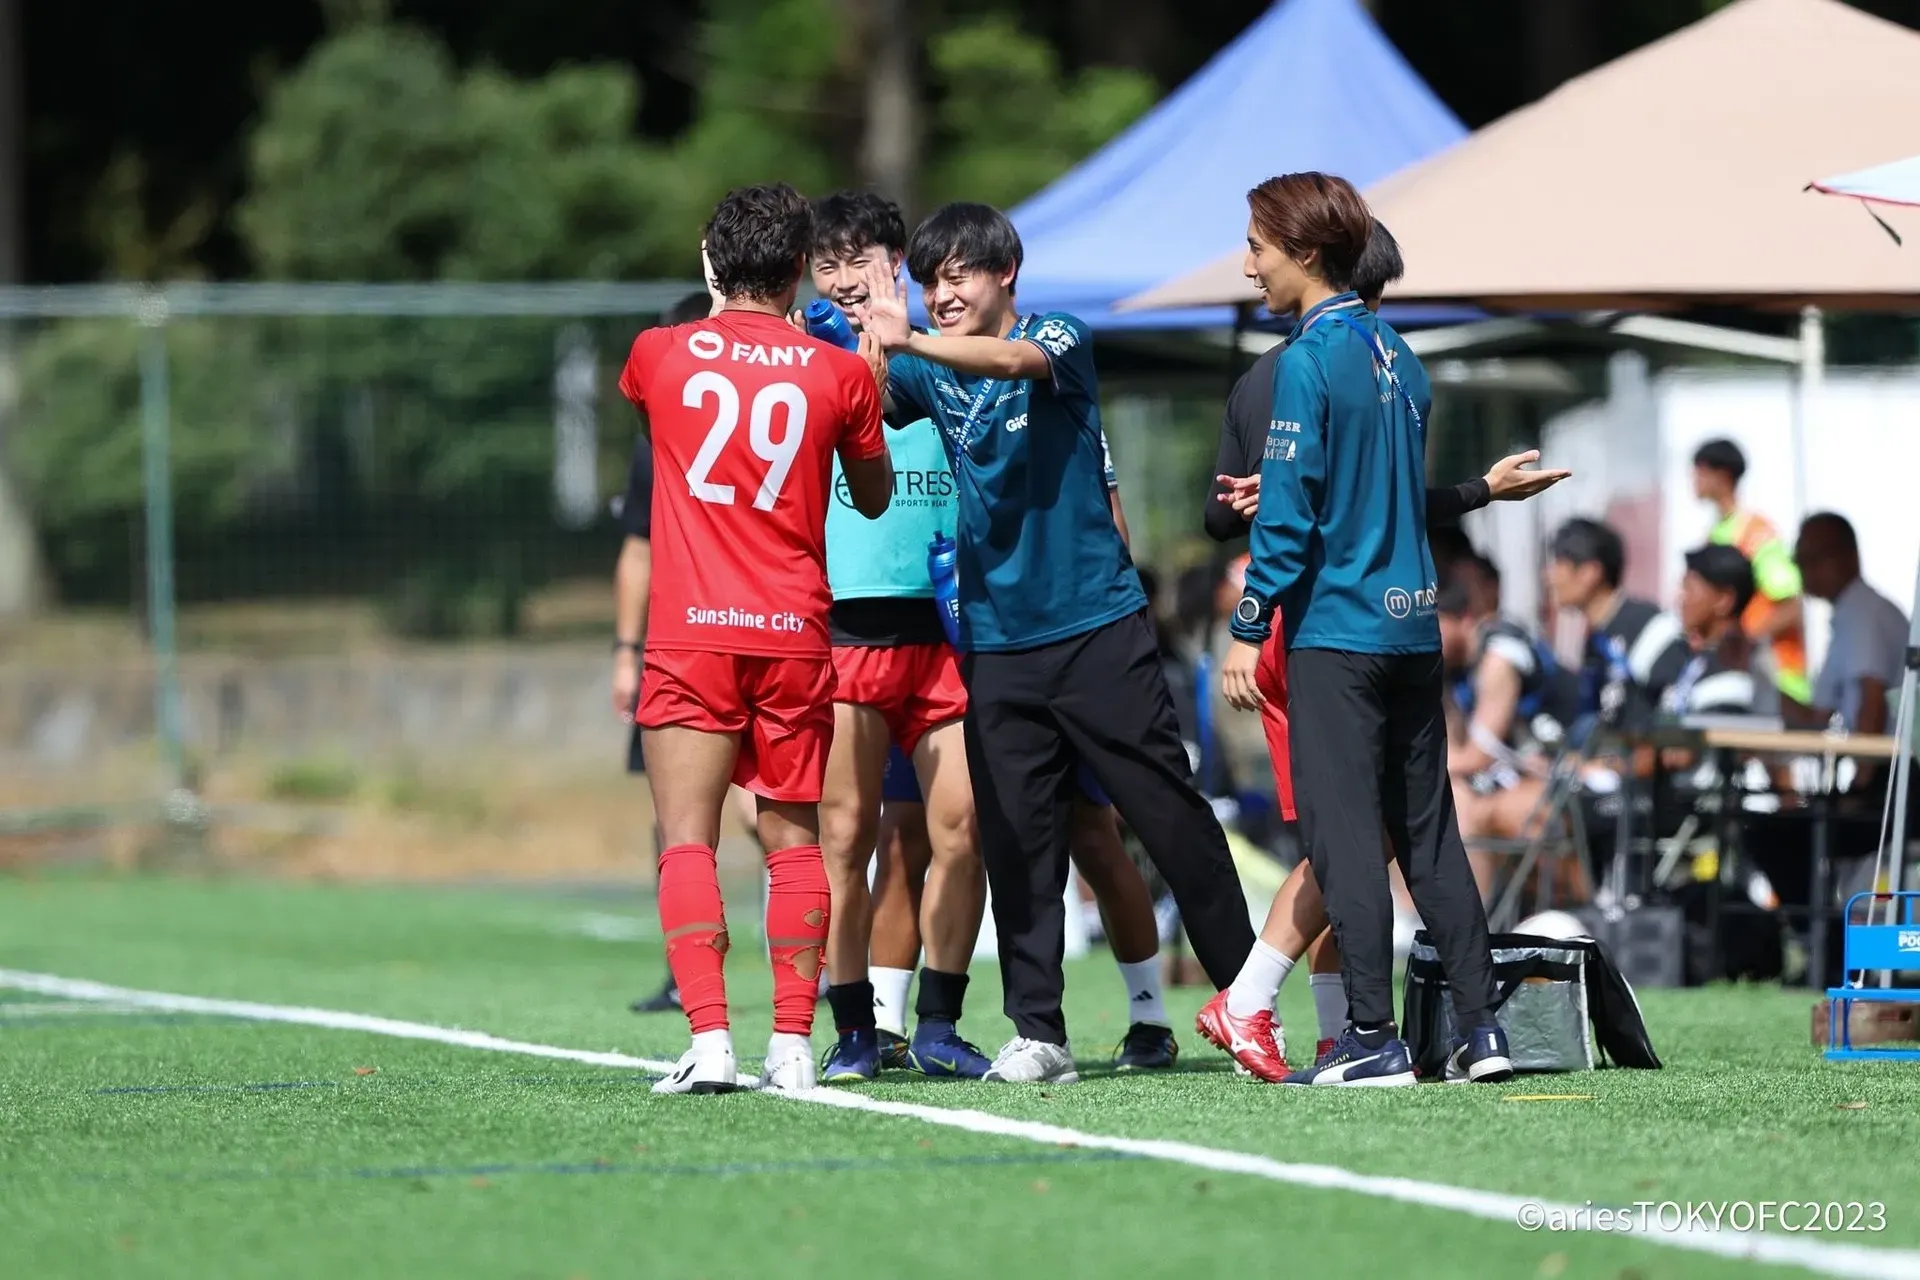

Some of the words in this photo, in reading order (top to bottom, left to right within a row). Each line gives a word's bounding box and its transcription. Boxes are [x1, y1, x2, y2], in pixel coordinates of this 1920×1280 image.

[731, 342, 816, 367] FANY
[958, 421, 971, 445] KANTO
[967, 394, 986, 421] SOCCER
[682, 370, 808, 512] 29
[892, 471, 952, 496] TRES
[895, 499, 929, 508] SPORTS
[686, 606, 766, 629] Sunshine
[771, 612, 805, 633] City
